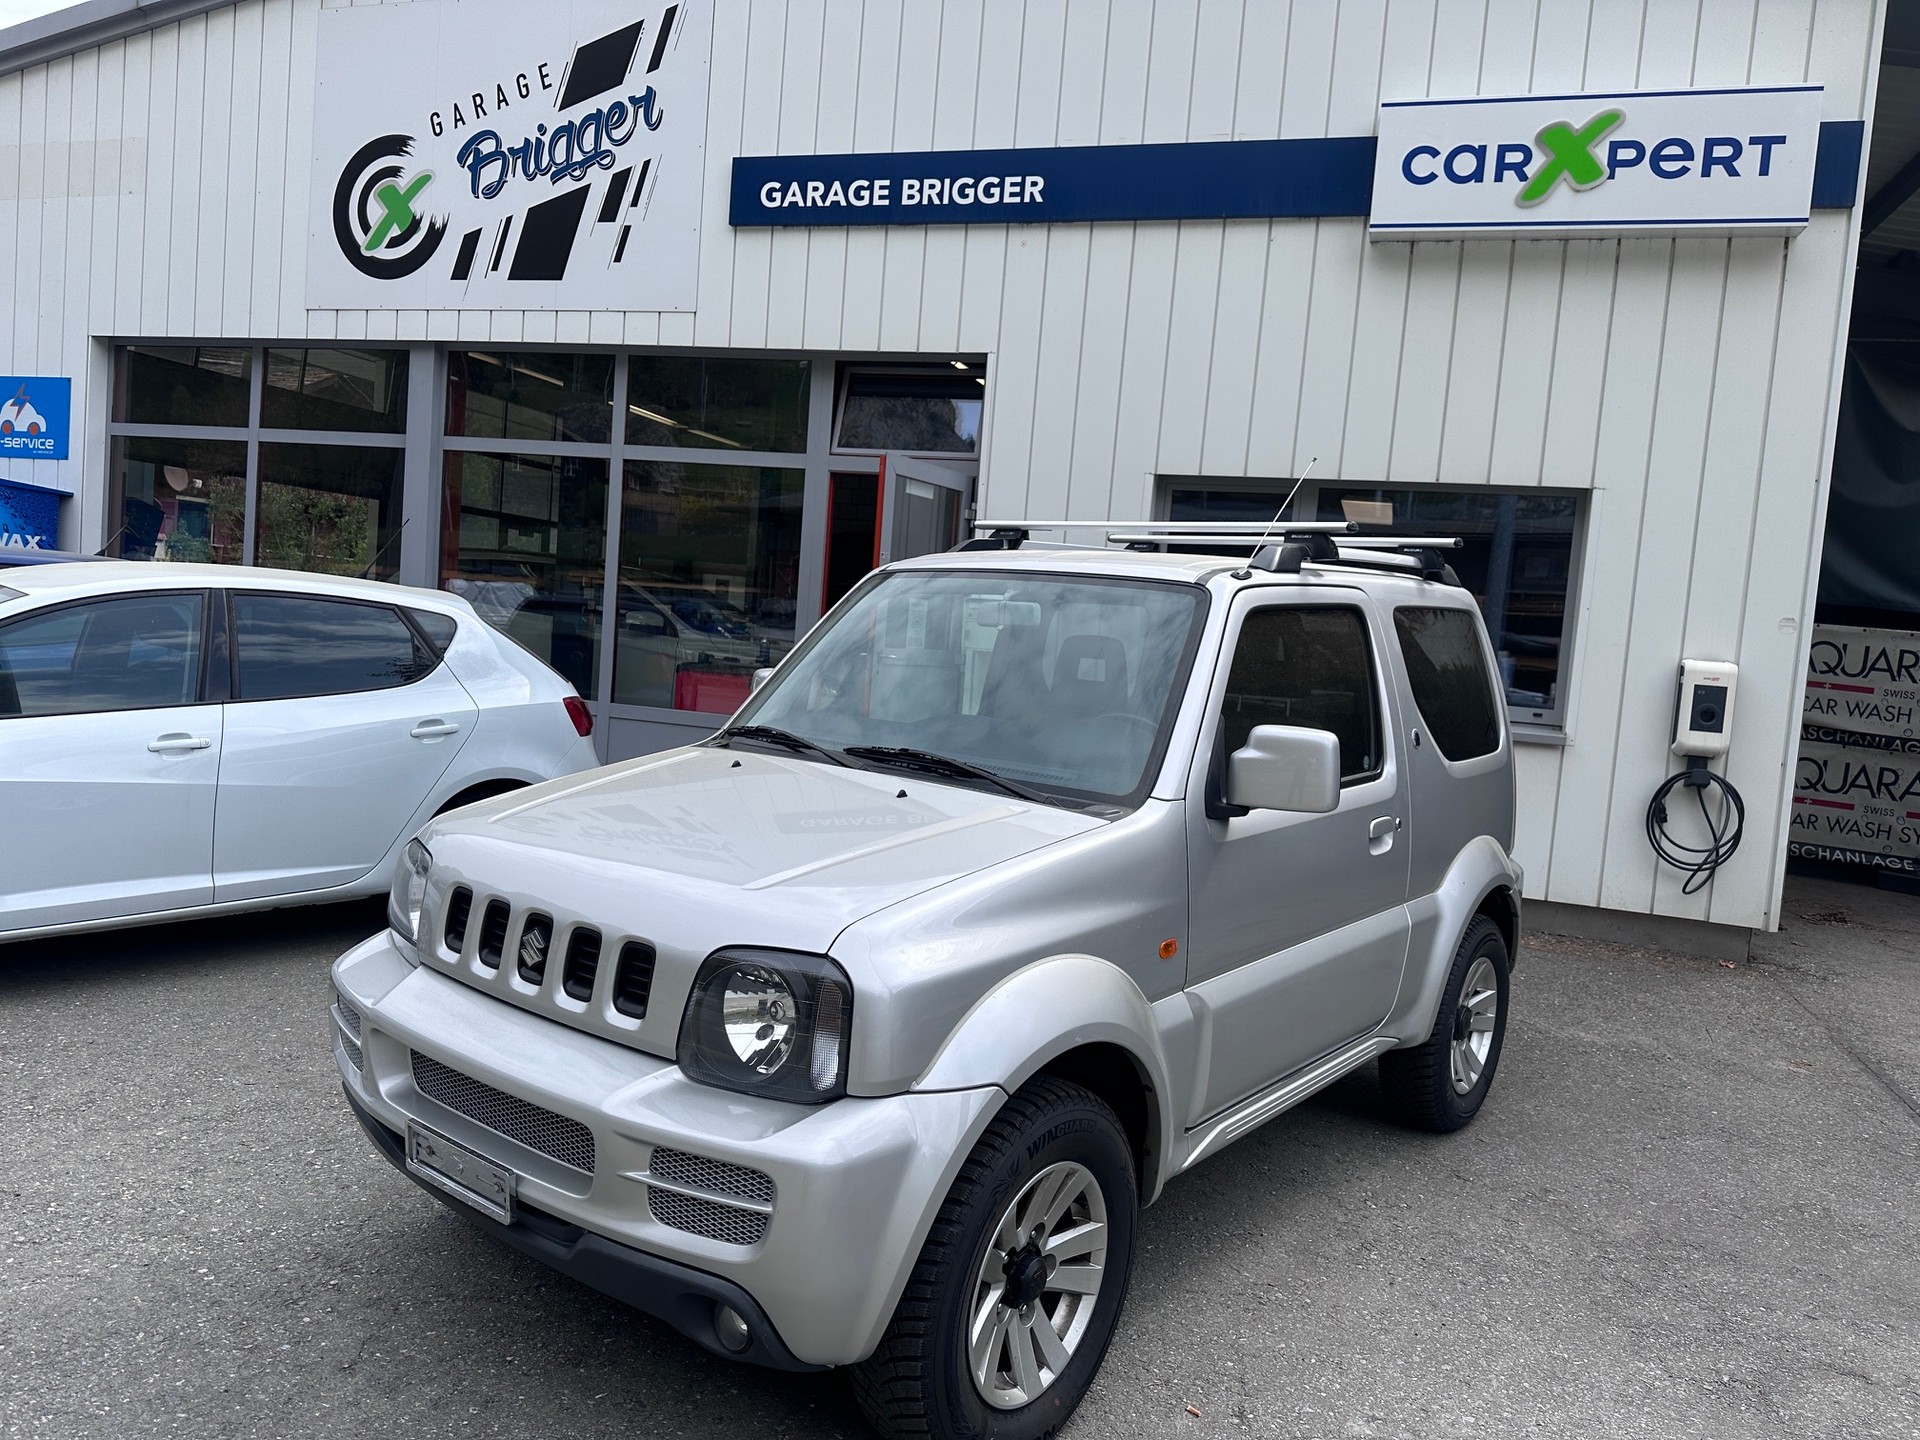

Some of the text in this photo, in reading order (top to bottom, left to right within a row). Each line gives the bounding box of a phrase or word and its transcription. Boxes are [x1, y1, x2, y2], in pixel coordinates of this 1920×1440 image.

[430, 62, 553, 137] GARAGE
[456, 85, 664, 199] Brigger
[760, 176, 1045, 208] GARAGE BRIGGER
[1808, 640, 1920, 684] QUAR
[1845, 700, 1913, 724] WASH
[1883, 688, 1916, 700] SWISS
[1794, 756, 1920, 802] QUARA
[1826, 816, 1898, 840] WASH
[1863, 805, 1896, 818] SWISS
[1026, 1118, 1097, 1160] WINGUARD
